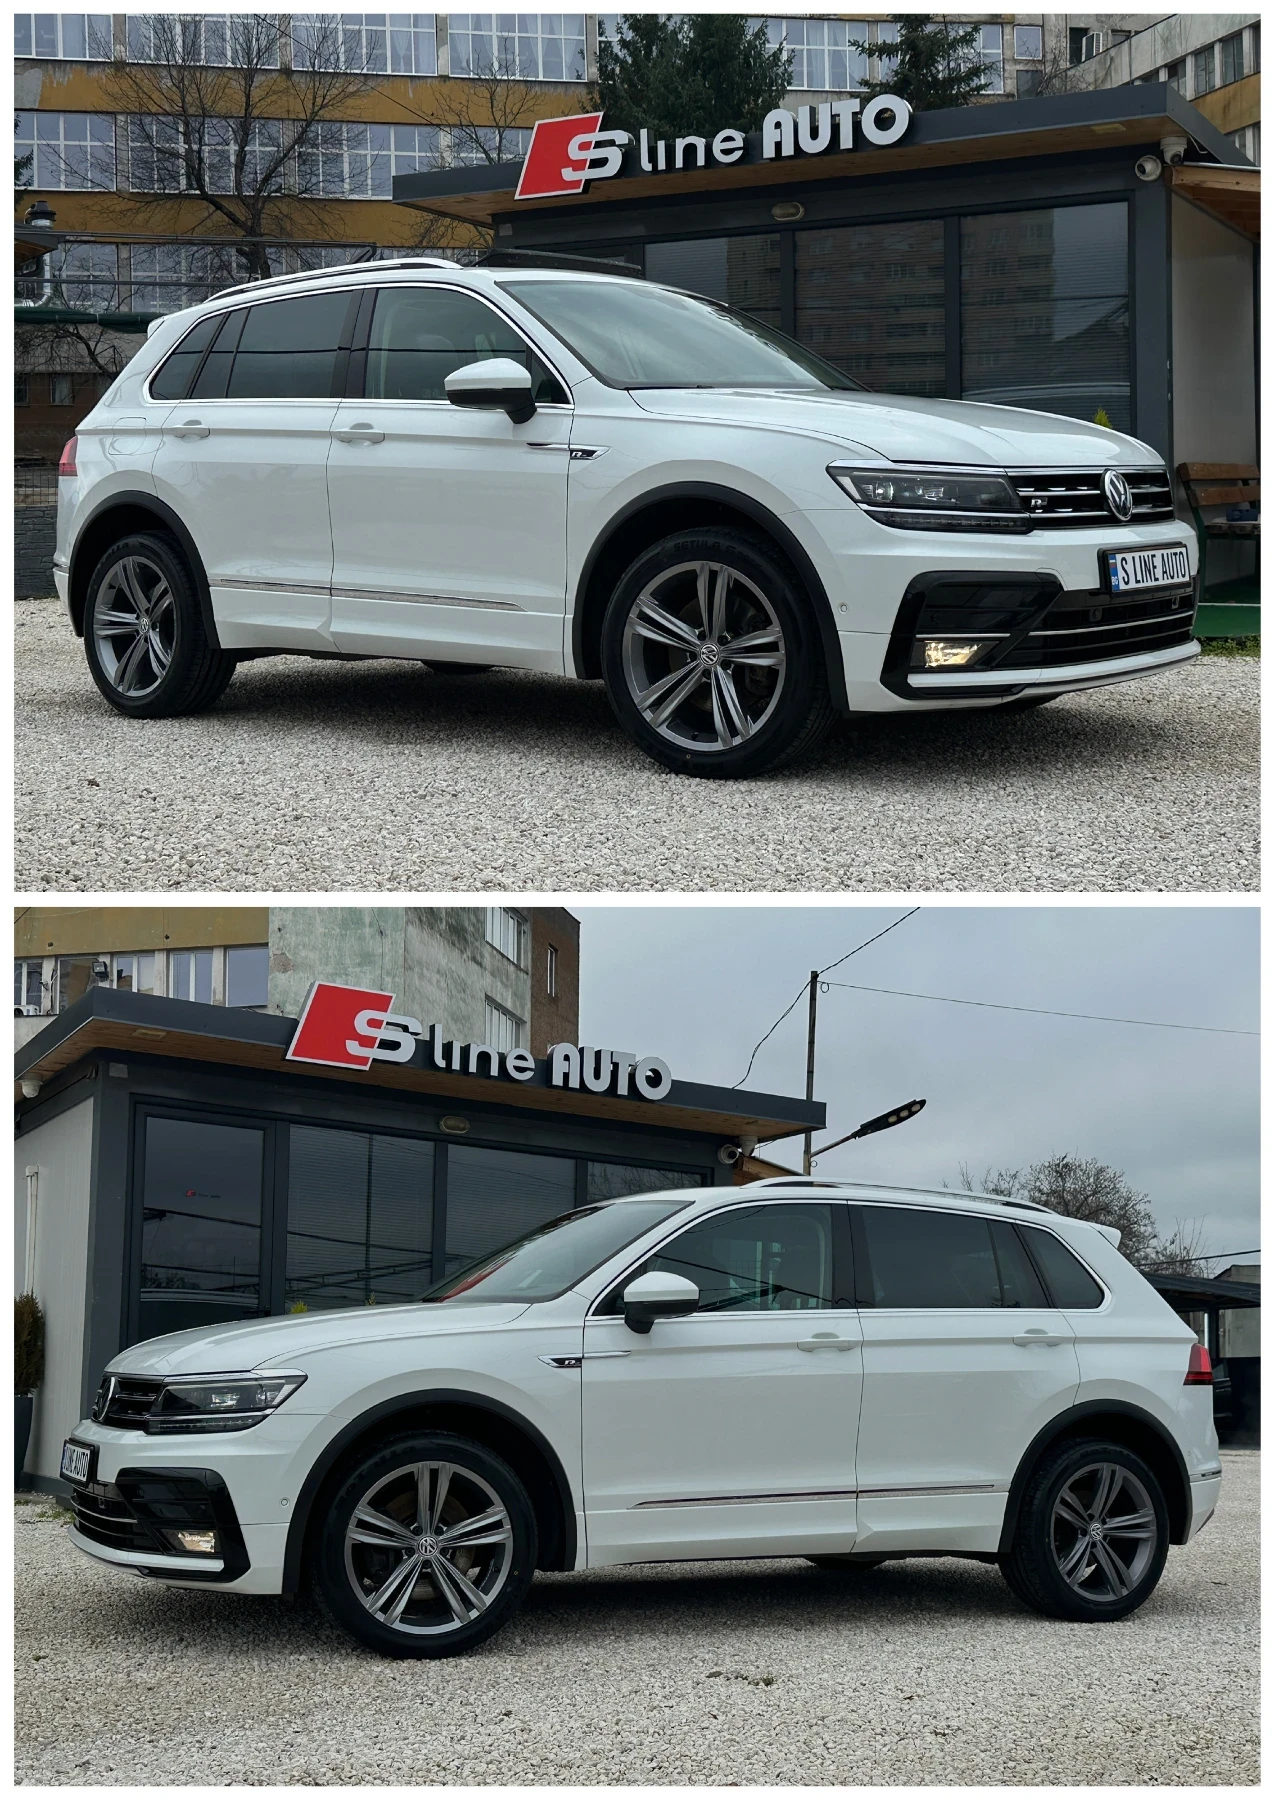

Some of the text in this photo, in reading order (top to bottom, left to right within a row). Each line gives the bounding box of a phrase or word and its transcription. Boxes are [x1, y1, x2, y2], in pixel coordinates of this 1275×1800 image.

[561, 94, 910, 182] S line AUTO
[1120, 551, 1187, 586] S LINE AUTO
[345, 1009, 672, 1100] S line AUTO
